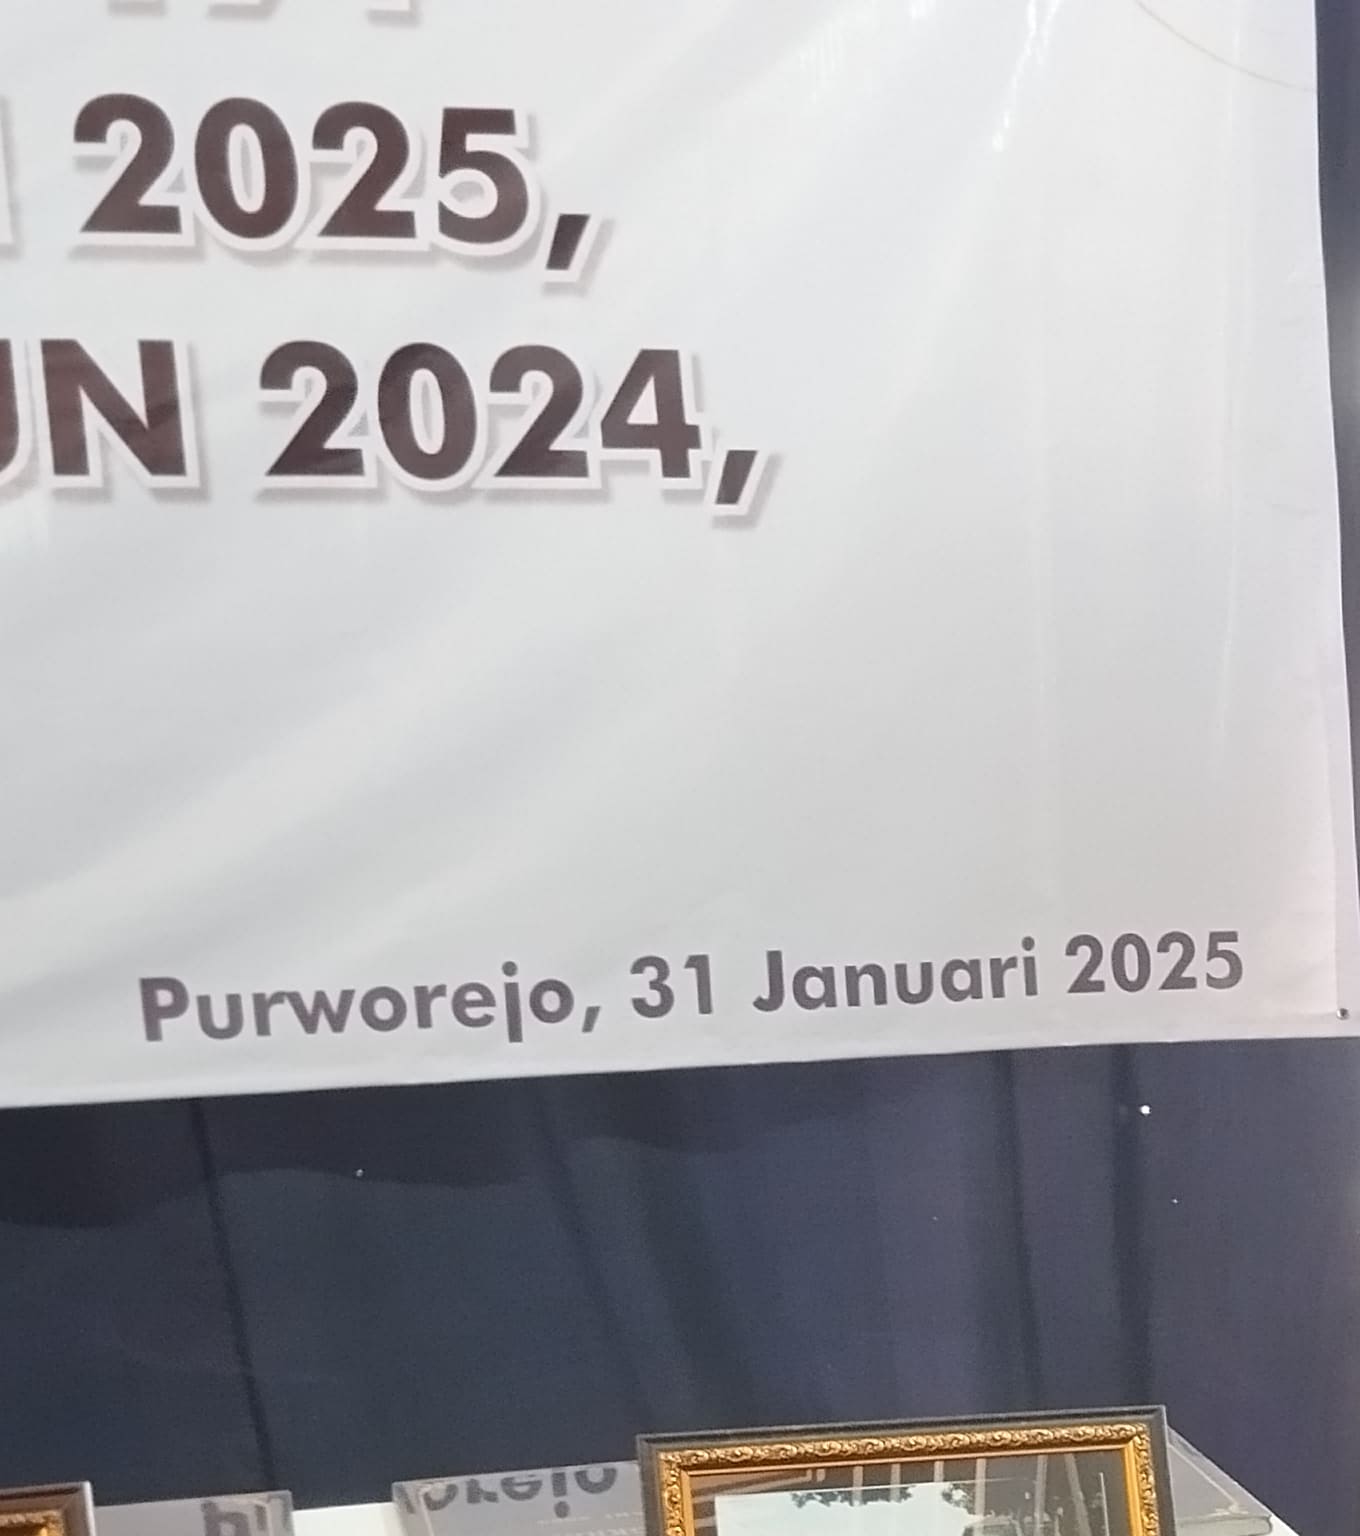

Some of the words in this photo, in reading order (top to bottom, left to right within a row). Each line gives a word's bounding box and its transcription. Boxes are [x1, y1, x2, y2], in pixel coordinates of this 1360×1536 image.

[73, 93, 591, 272] 2025,
[258, 340, 760, 506] 2024,
[138, 959, 602, 1043] Purworejo,
[629, 953, 714, 1018] 31
[752, 936, 1040, 1013] Januari
[1064, 930, 1244, 994] 2025
